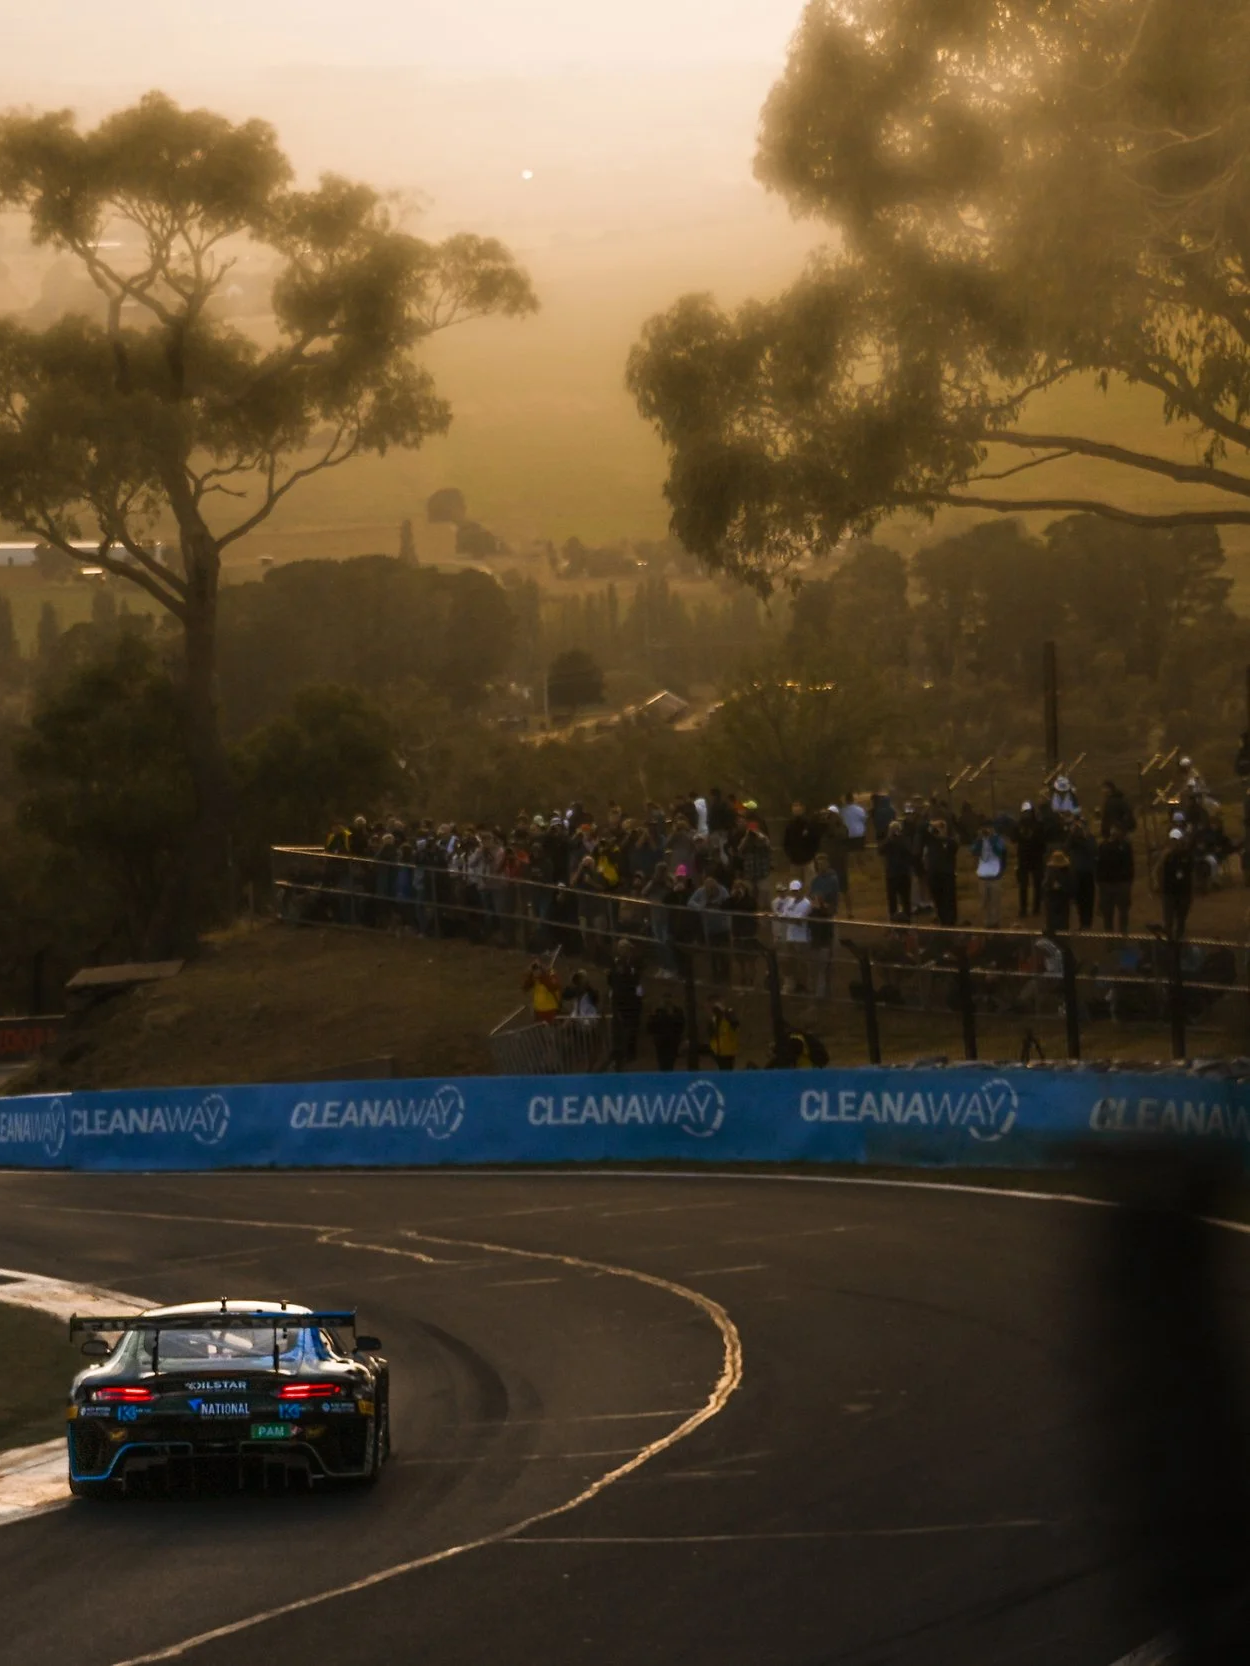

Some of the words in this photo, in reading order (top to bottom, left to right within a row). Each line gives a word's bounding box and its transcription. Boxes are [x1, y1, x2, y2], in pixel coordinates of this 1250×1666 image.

[70, 1101, 228, 1138] CLEANAWAY
[291, 1094, 462, 1132] CLEANAWAY
[528, 1089, 722, 1129] CLEANAWAY
[800, 1086, 1016, 1130] CLEANAWAY
[201, 1402, 250, 1415] NATIONAL
[258, 1425, 285, 1437] PAM
